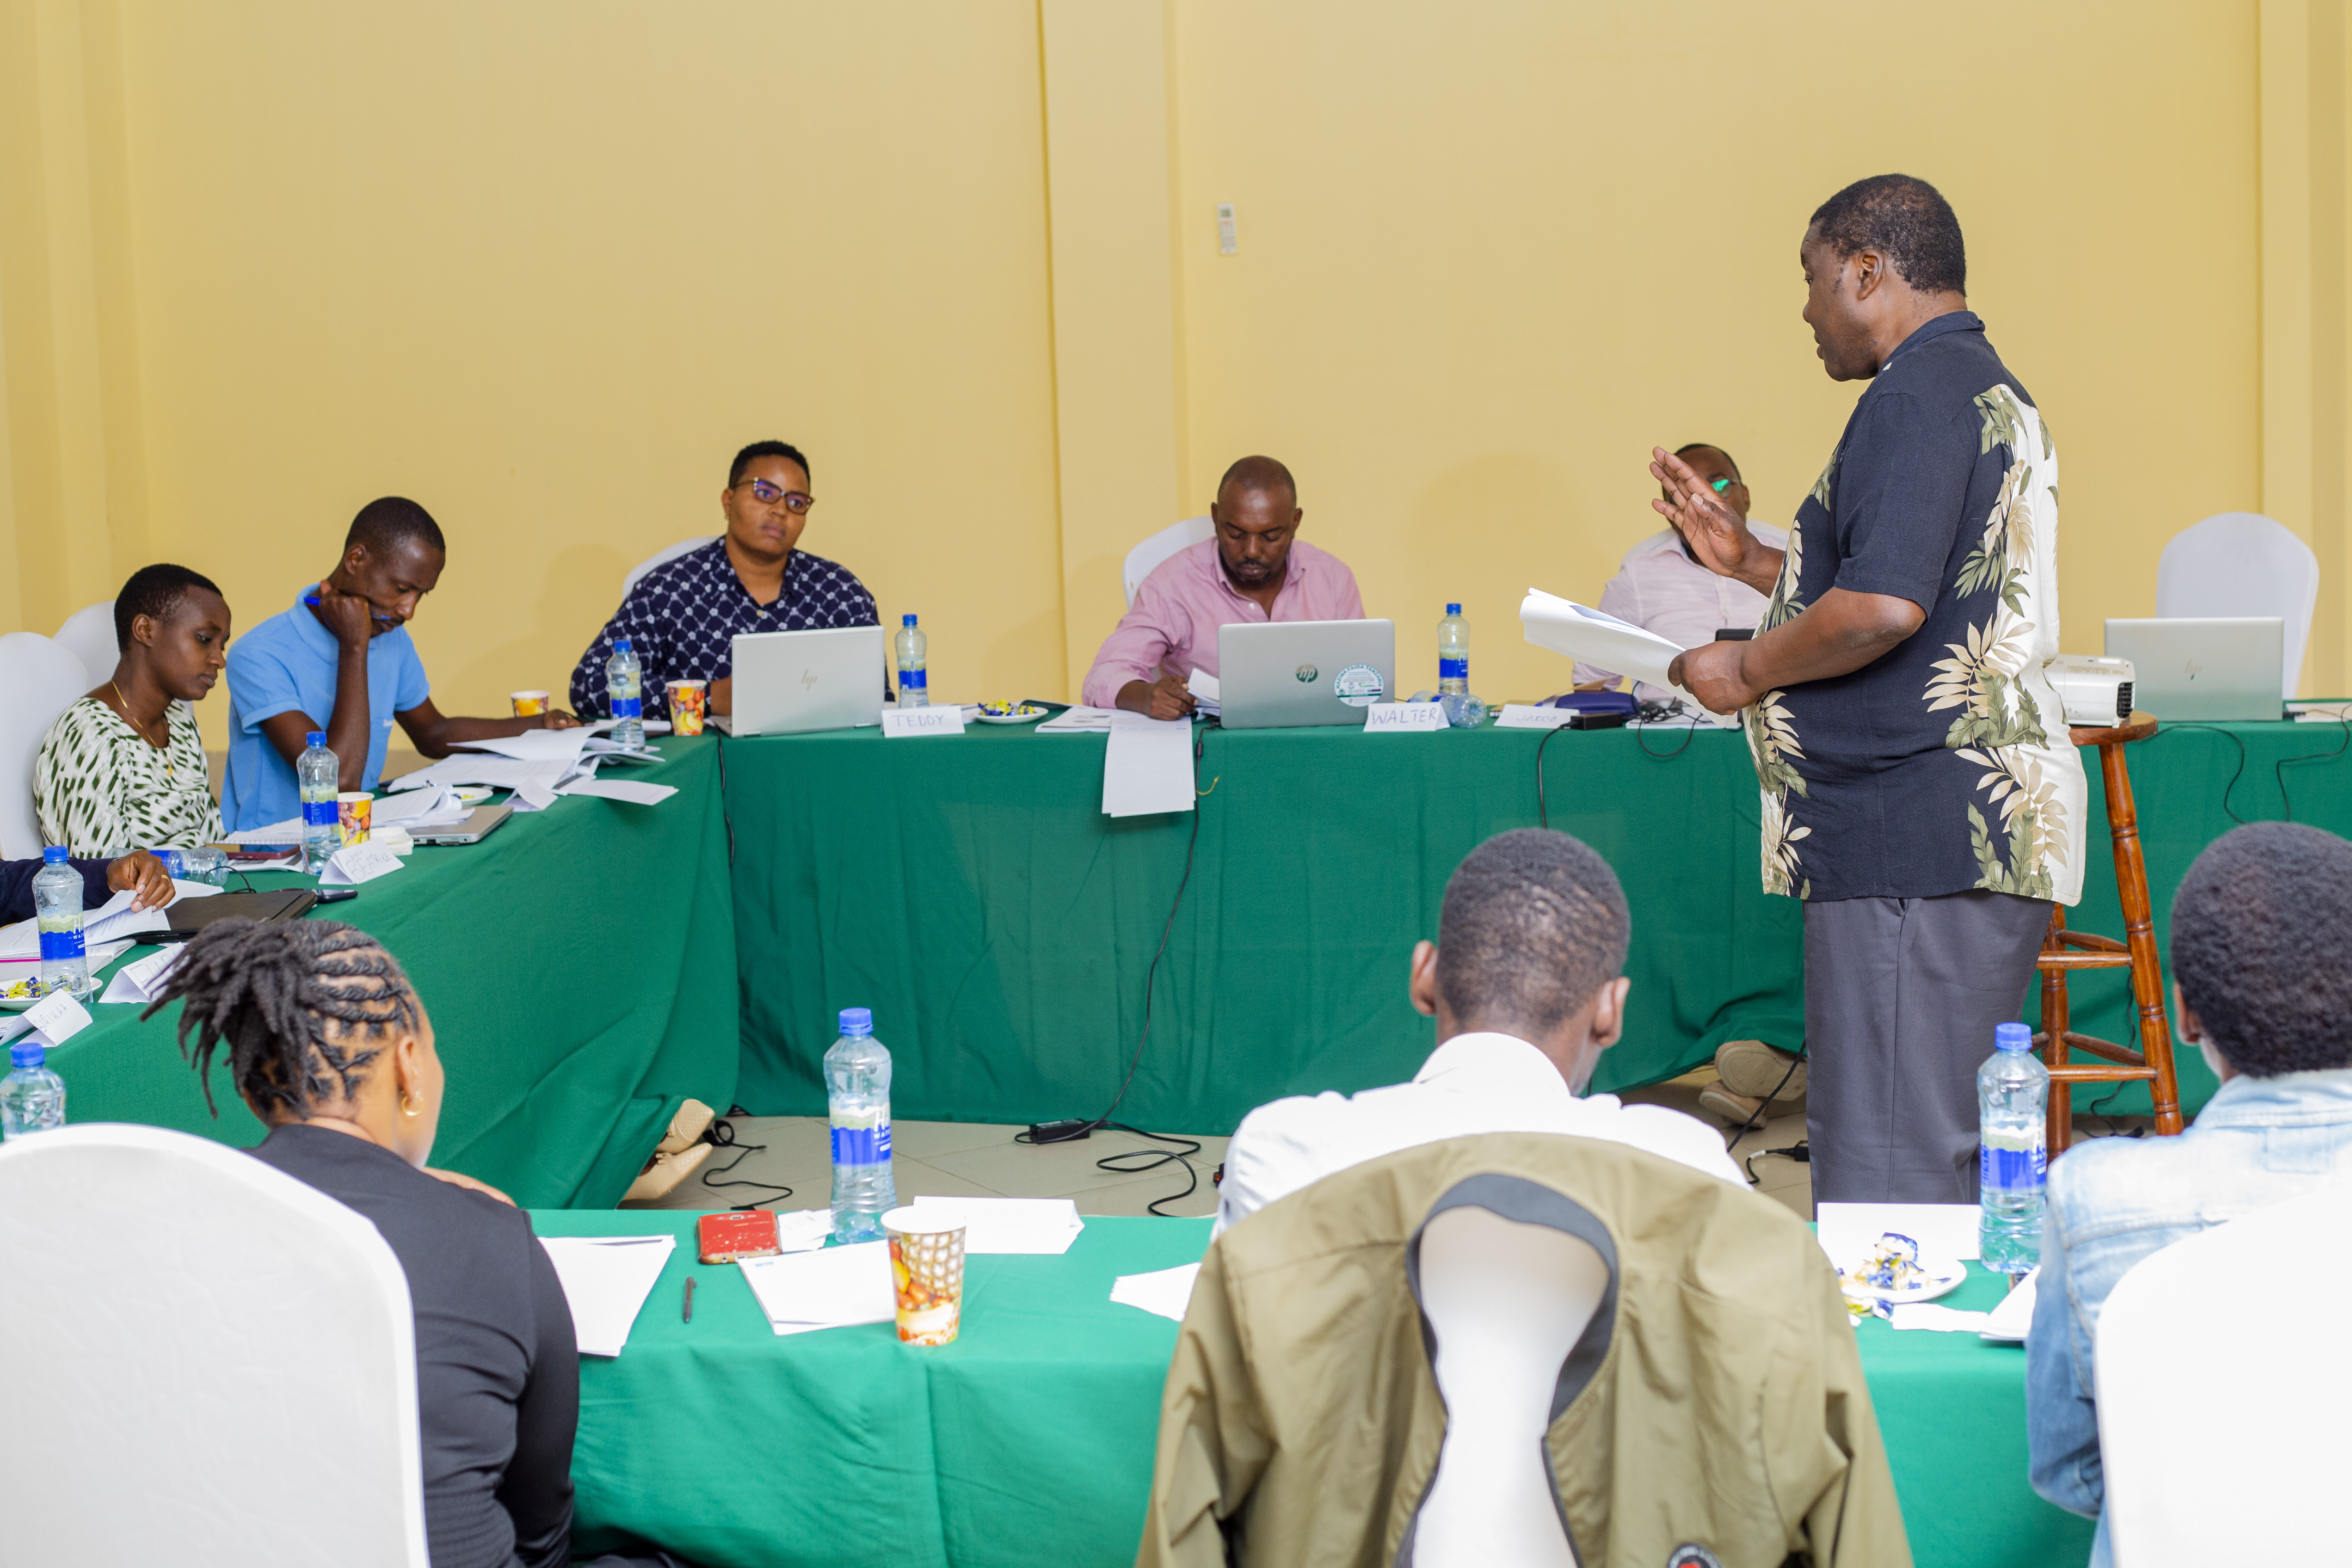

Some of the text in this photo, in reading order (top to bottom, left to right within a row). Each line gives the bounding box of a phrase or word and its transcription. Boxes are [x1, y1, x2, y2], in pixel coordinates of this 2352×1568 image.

[1298, 665, 1317, 683] hp
[1366, 666, 1383, 687] TANZANIA
[2184, 659, 2203, 680] hp
[800, 669, 818, 691] hp
[891, 714, 945, 727] TEDDY
[1372, 707, 1437, 725] WALTER
[1516, 713, 1558, 722] JACOB
